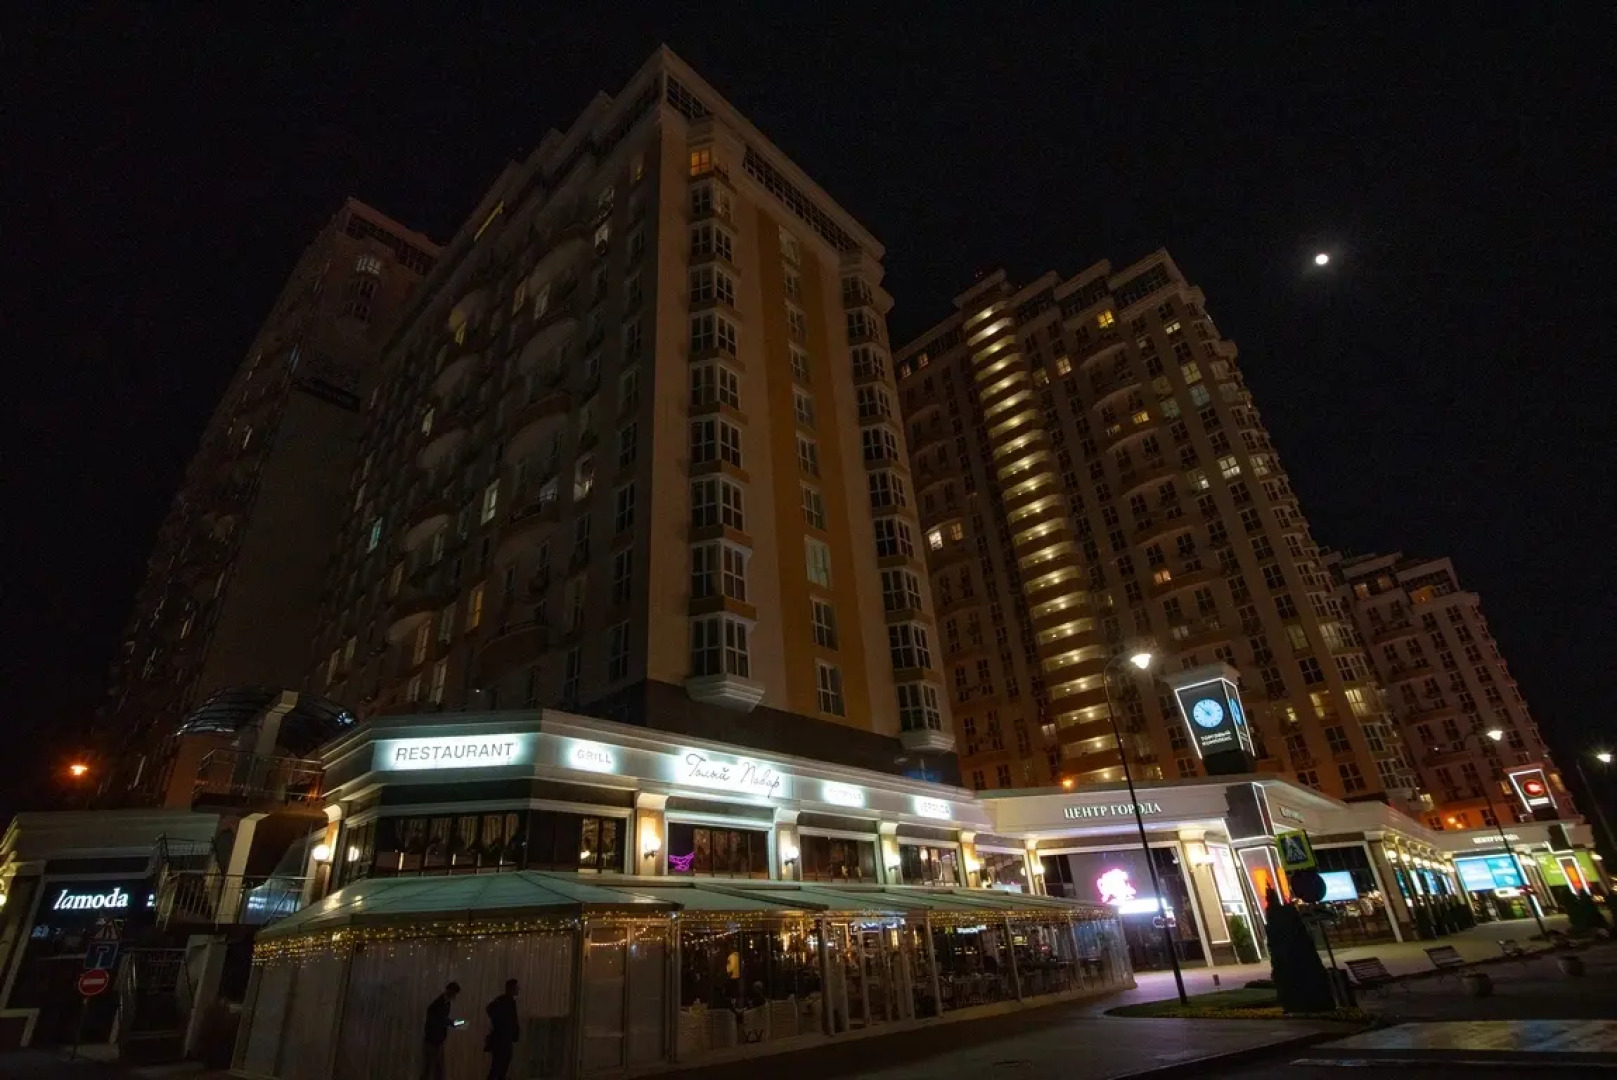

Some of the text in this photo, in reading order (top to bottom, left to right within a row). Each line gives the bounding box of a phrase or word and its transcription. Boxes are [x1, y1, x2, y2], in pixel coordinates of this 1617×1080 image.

[395, 742, 514, 761] RESTAURANT
[577, 749, 611, 765] GRILL
[740, 761, 780, 799] Повар
[1064, 805, 1107, 819] ЦЕНТР
[53, 886, 129, 911] lamoda
